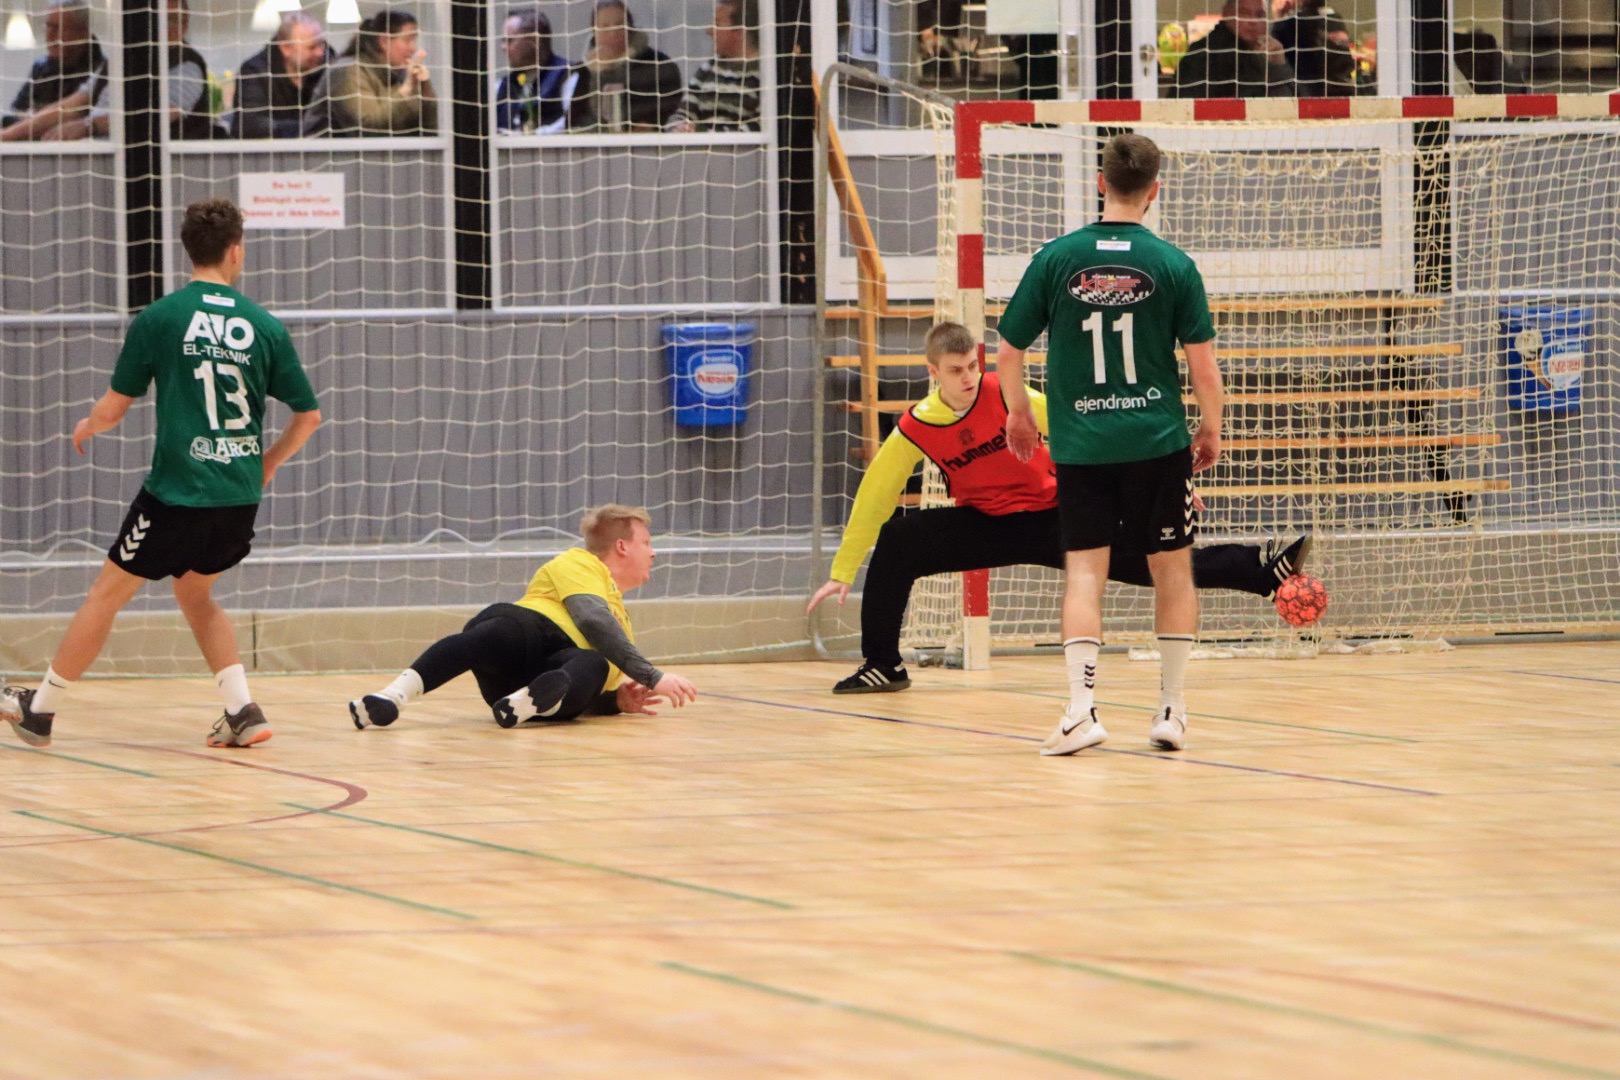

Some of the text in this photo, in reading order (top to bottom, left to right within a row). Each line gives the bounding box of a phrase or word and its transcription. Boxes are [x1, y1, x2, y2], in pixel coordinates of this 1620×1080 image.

[183, 343, 251, 365] EL-TEKNIK
[1082, 311, 1137, 384] 11
[193, 360, 251, 430] 13
[1074, 394, 1147, 414] ejendrøm
